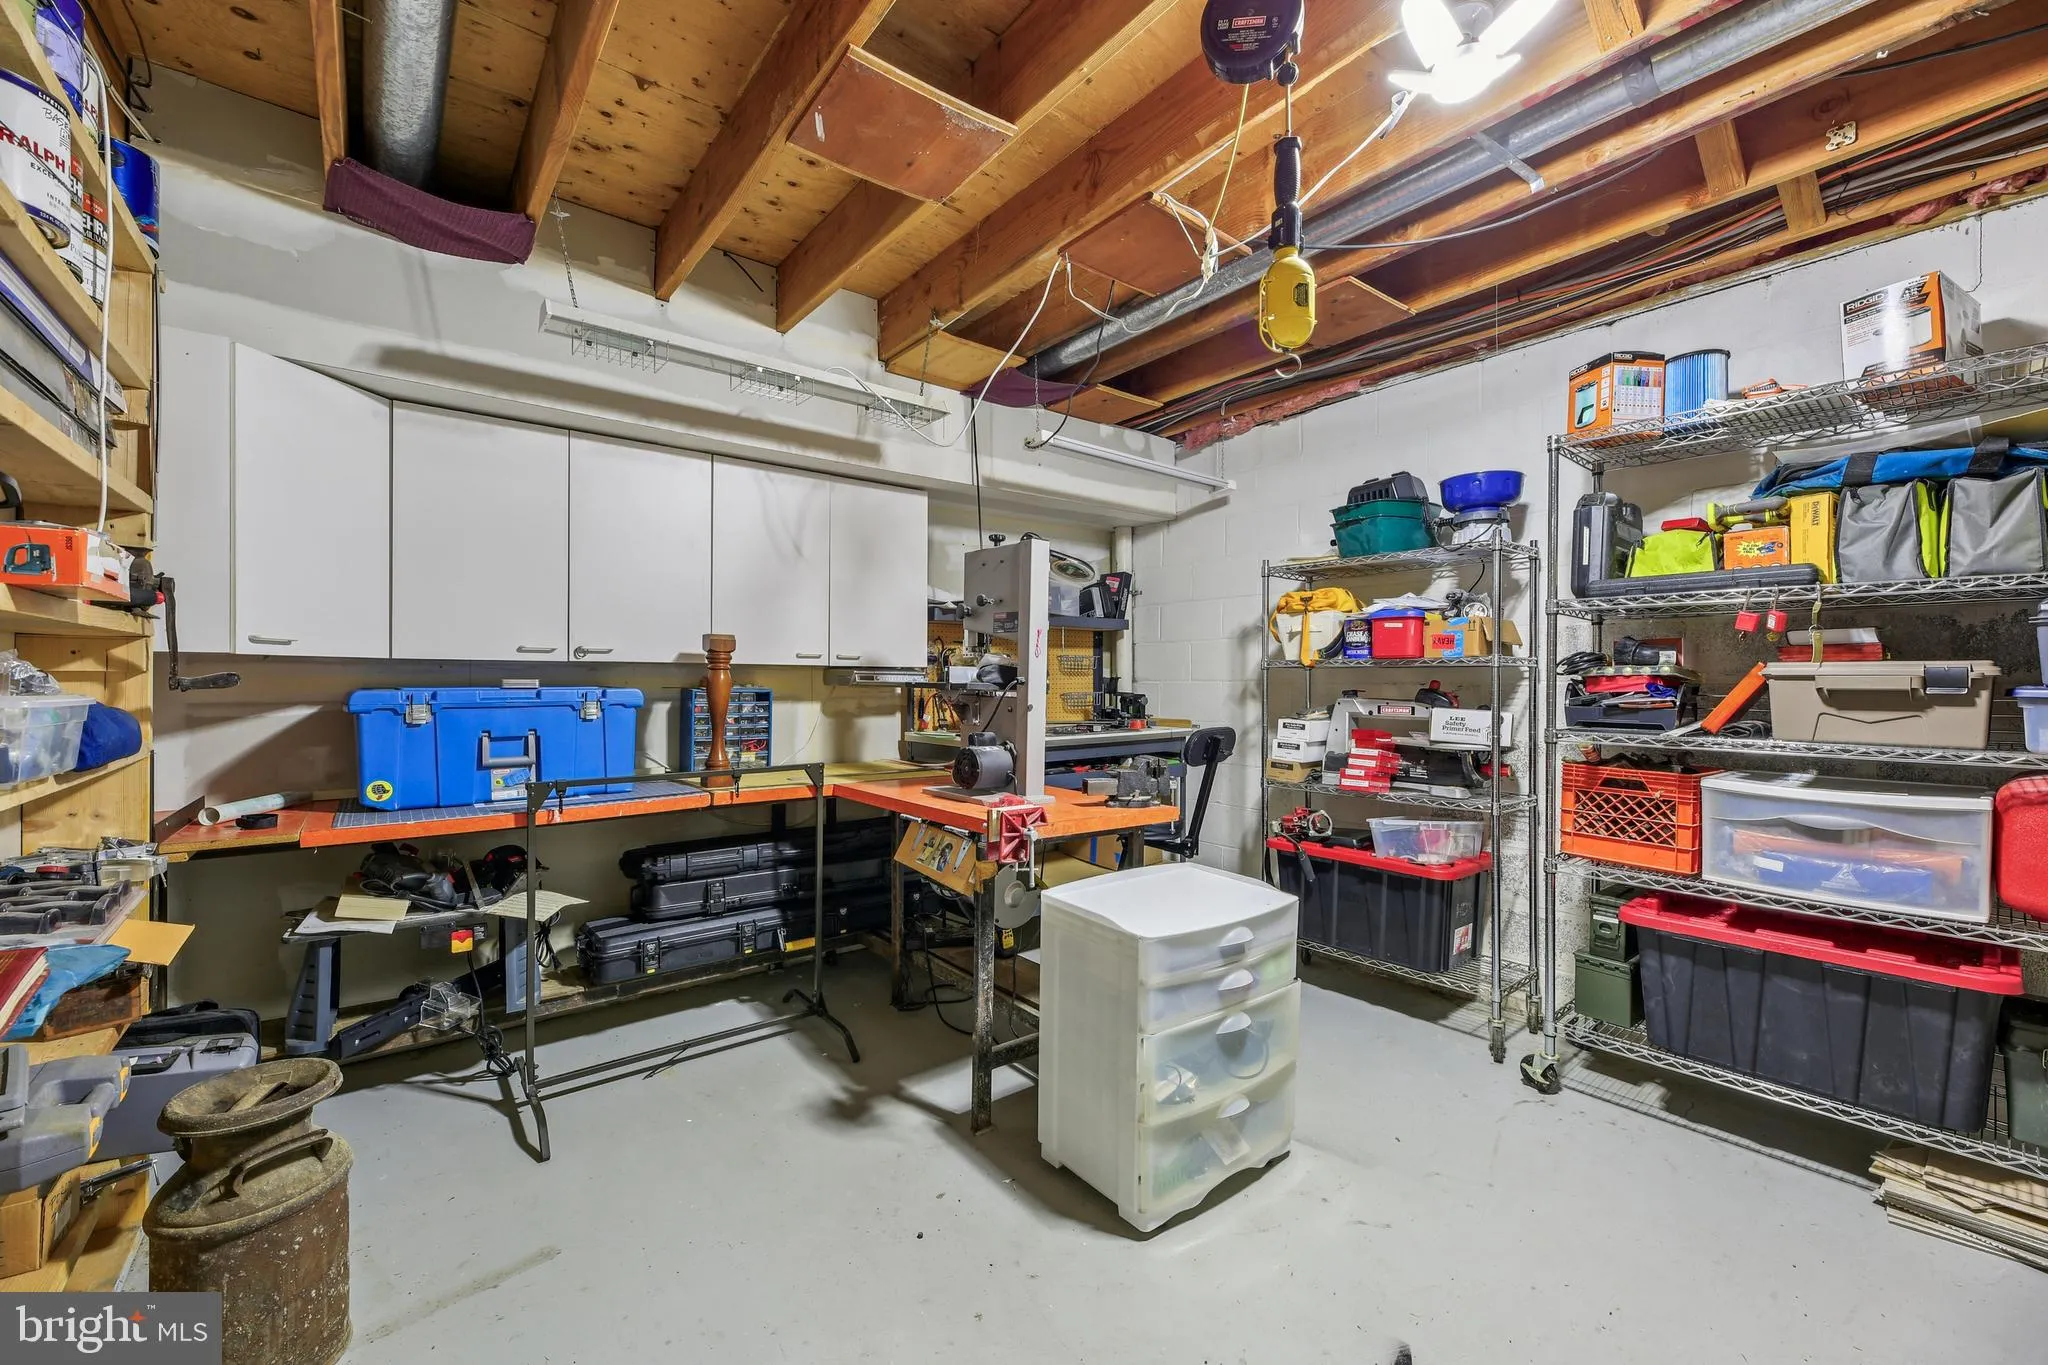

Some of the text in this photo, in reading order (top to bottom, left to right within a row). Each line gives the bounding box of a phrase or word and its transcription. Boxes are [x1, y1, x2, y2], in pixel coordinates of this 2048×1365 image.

[1234, 19, 1265, 27] CRAFTSMAN
[0, 126, 66, 173] RALPH
[1845, 293, 1885, 312] RIDGID
[1445, 720, 1467, 728] Safety
